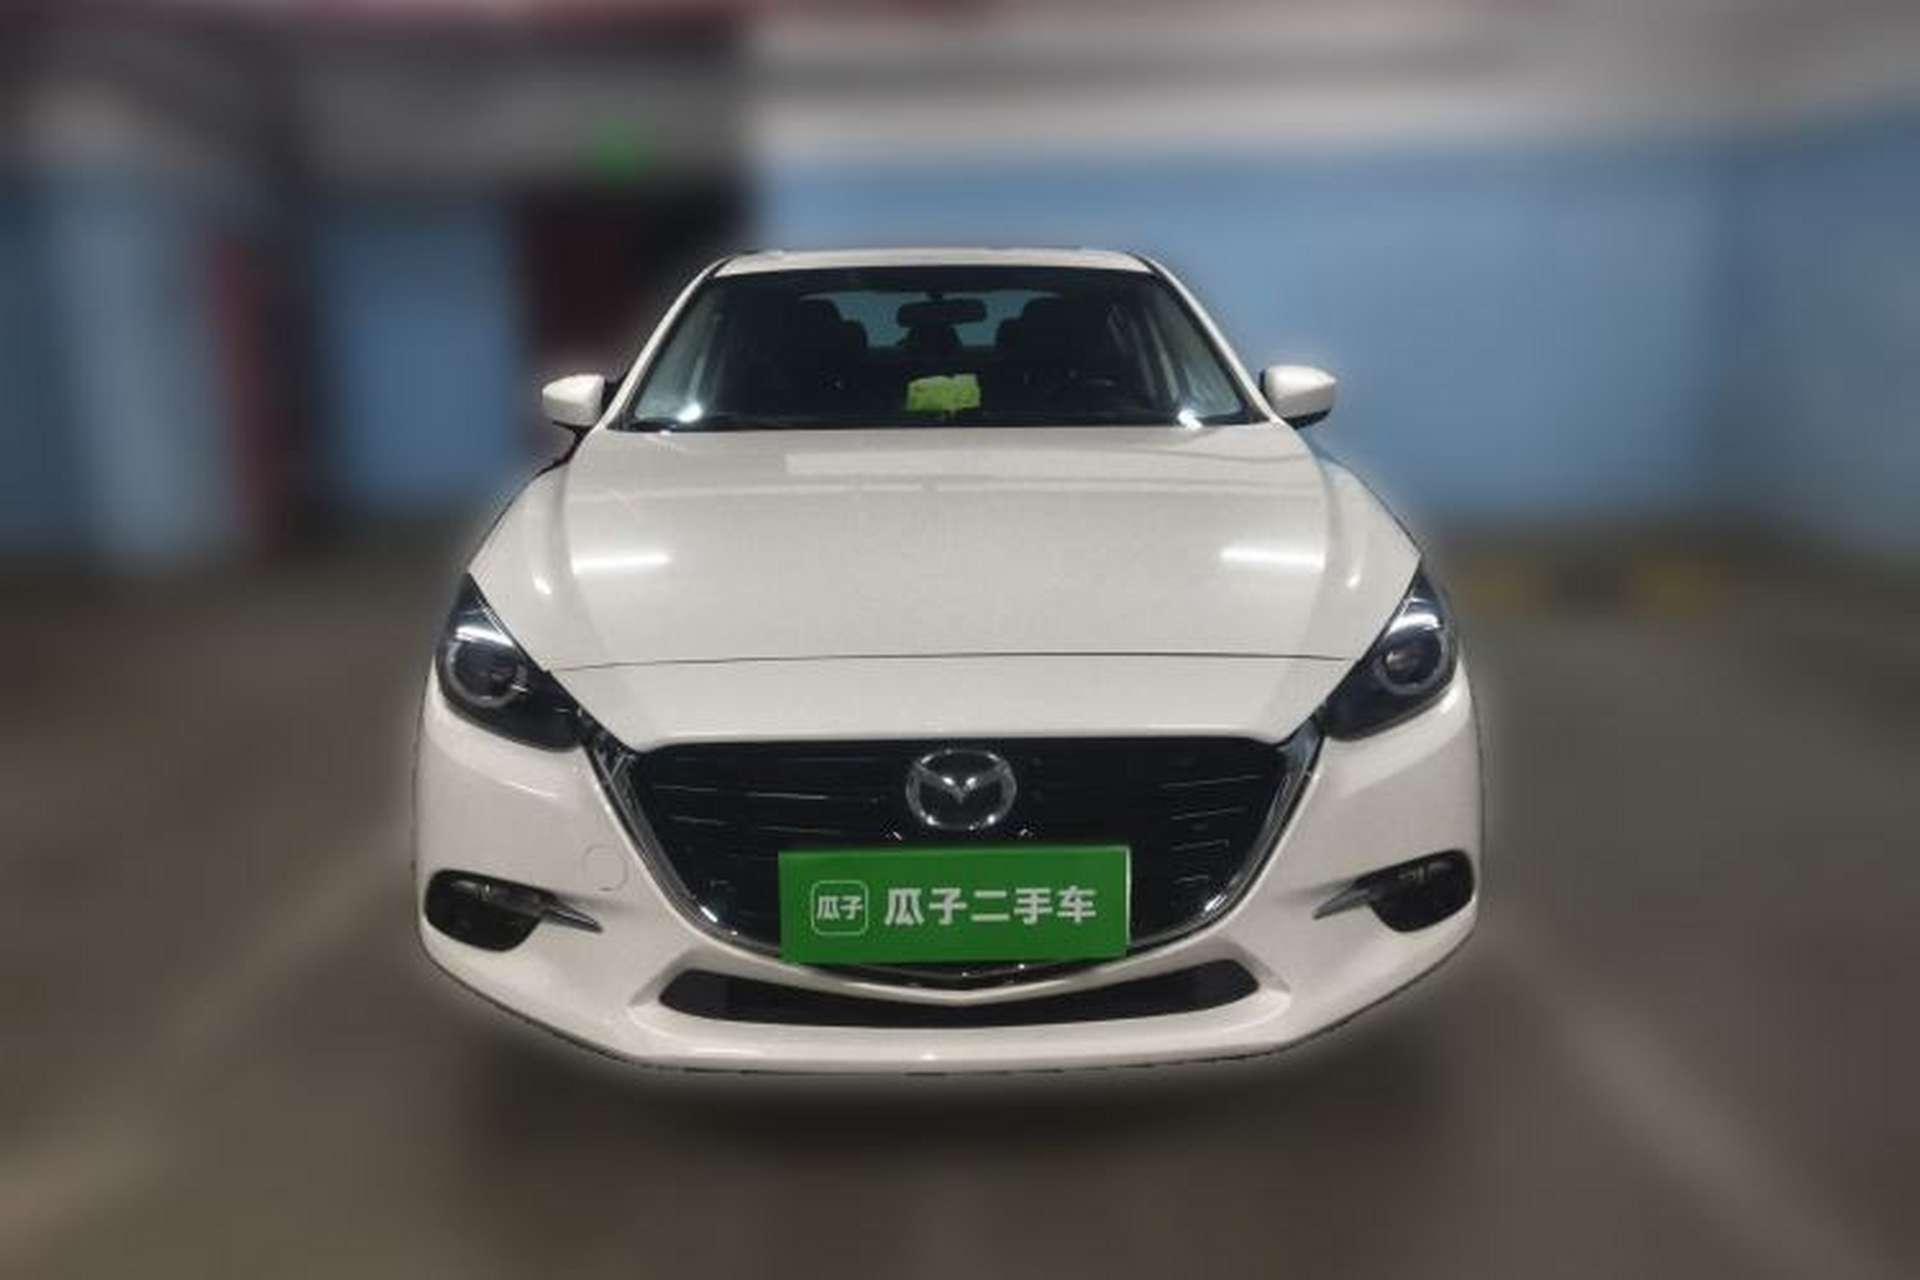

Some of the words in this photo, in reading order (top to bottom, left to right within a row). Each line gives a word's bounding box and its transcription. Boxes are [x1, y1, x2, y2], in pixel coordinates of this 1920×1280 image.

[816, 895, 863, 920] 瓜子
[884, 885, 1097, 926] 瓜子二手车
